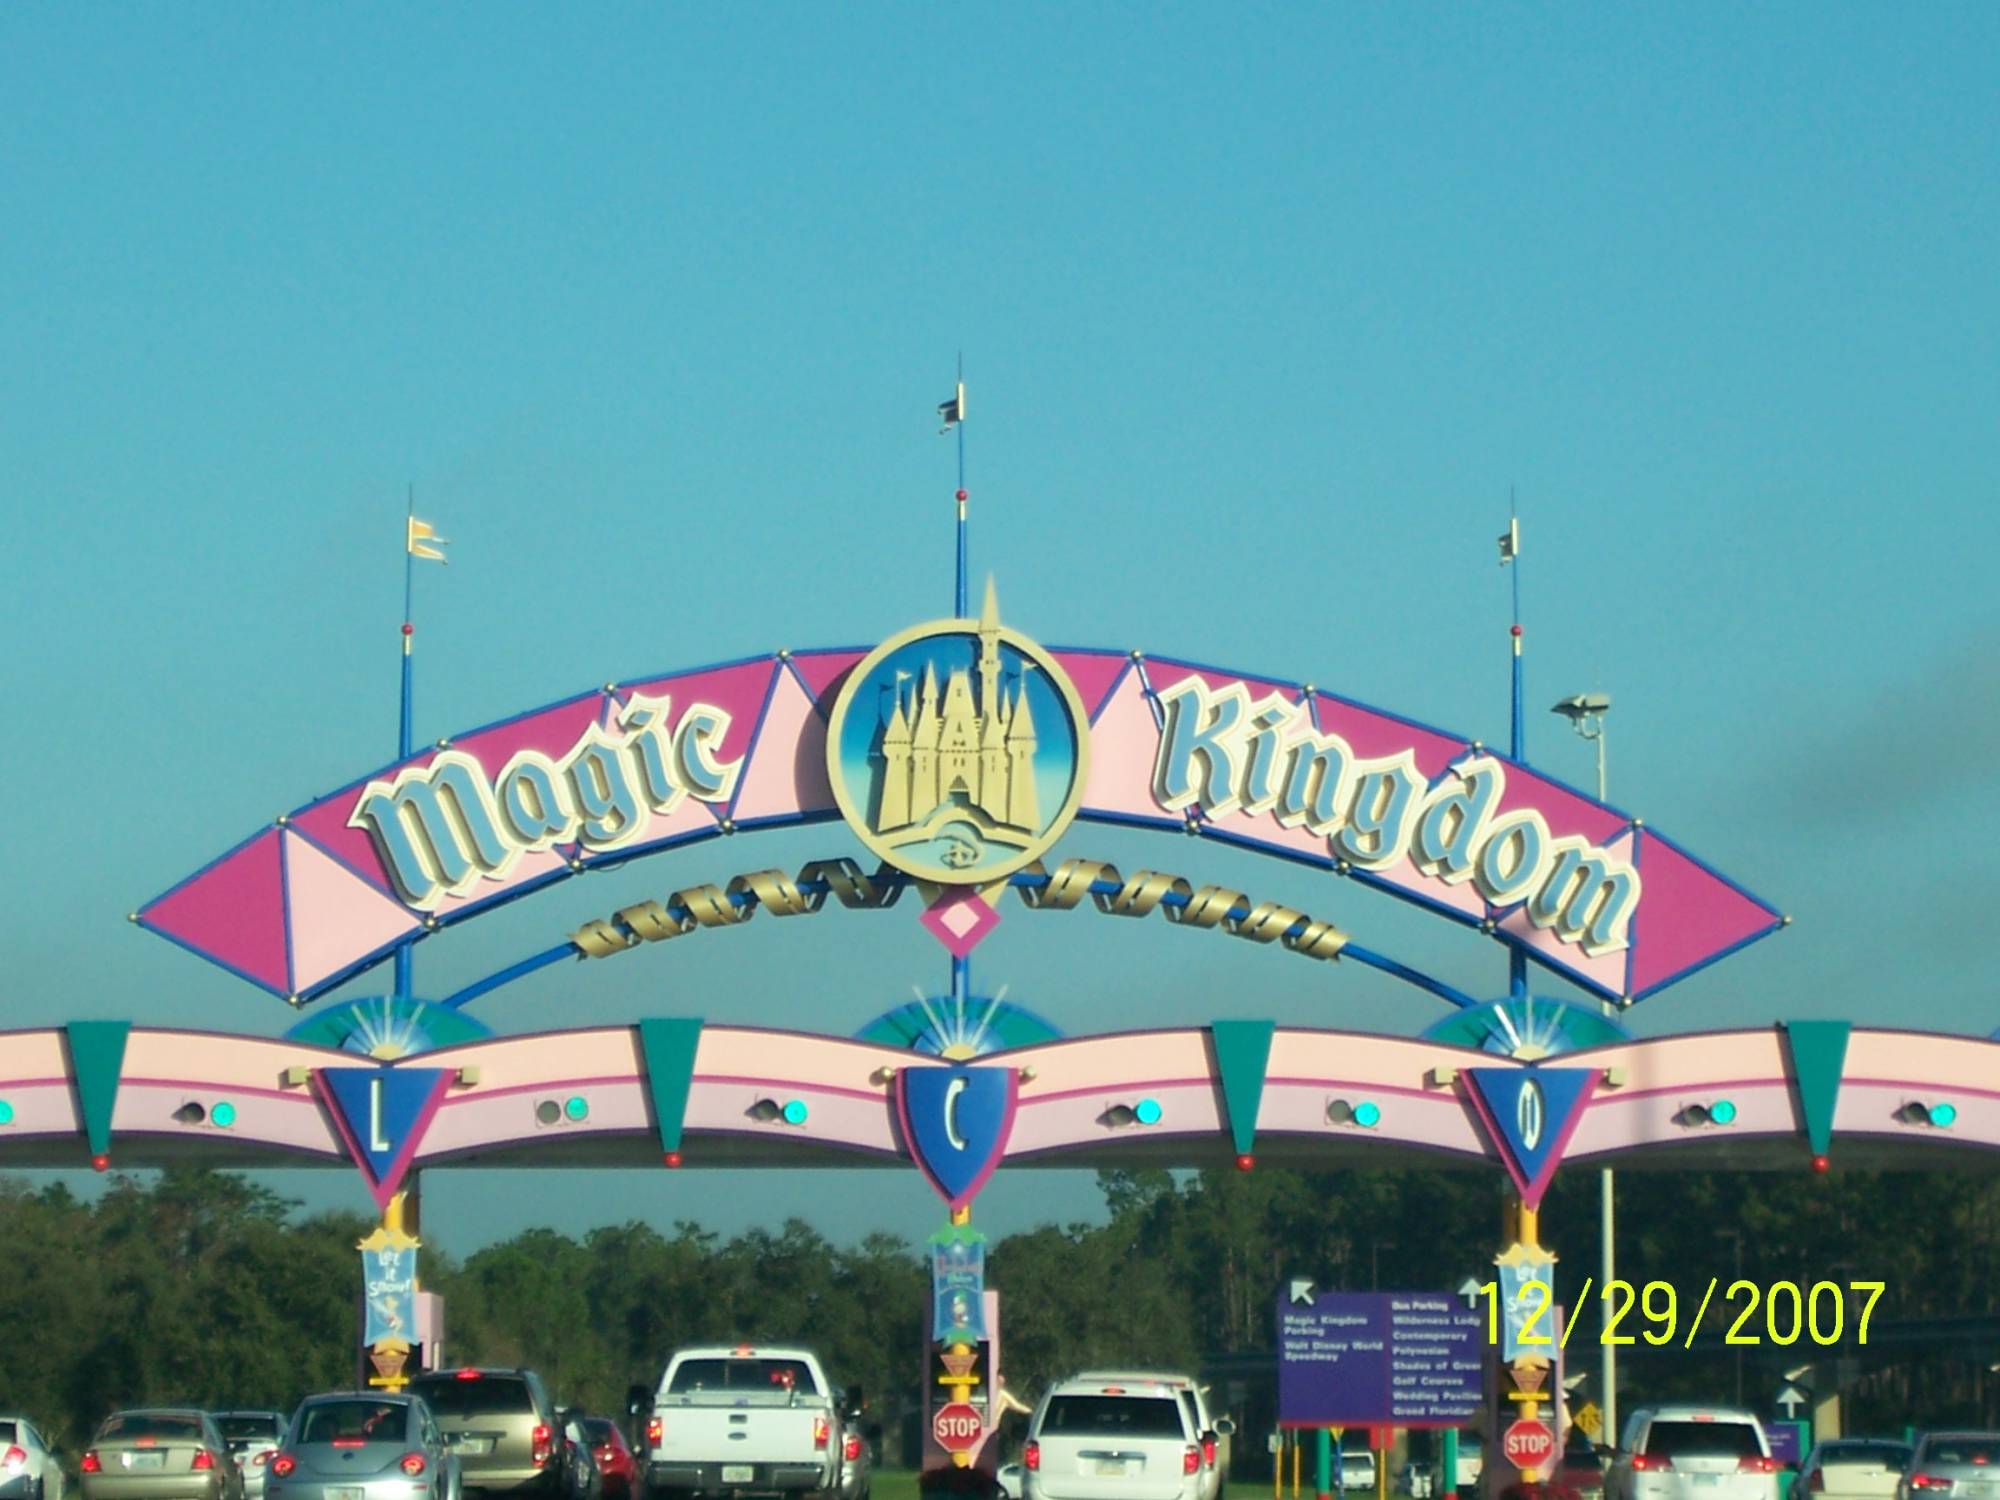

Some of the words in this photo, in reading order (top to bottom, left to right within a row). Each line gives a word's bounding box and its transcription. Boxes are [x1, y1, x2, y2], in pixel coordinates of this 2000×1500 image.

[347, 692, 744, 911] Magic
[1151, 675, 1642, 957] Kingdom
[370, 1078, 390, 1152] L
[1412, 1301, 1449, 1313] Parking
[1284, 1315, 1316, 1328] Magic
[1320, 1315, 1368, 1327] Kingdom
[1392, 1315, 1450, 1326] Wilderness
[1453, 1315, 1481, 1328] Lodg
[1284, 1325, 1325, 1337] Parking
[1392, 1331, 1468, 1342] Contemporary
[1284, 1341, 1309, 1351] Walt
[1312, 1341, 1349, 1352] Disney
[1352, 1341, 1384, 1351] World
[1392, 1346, 1450, 1357] Polynesian
[1284, 1351, 1339, 1362] Speedway
[1392, 1361, 1431, 1371] Shades
[1435, 1361, 1448, 1371] of
[1392, 1376, 1417, 1386] Golf
[1420, 1376, 1464, 1386] Courses
[1392, 1391, 1440, 1403] Wedding
[937, 1417, 980, 1438] STOP
[1507, 1434, 1550, 1455] STOP
